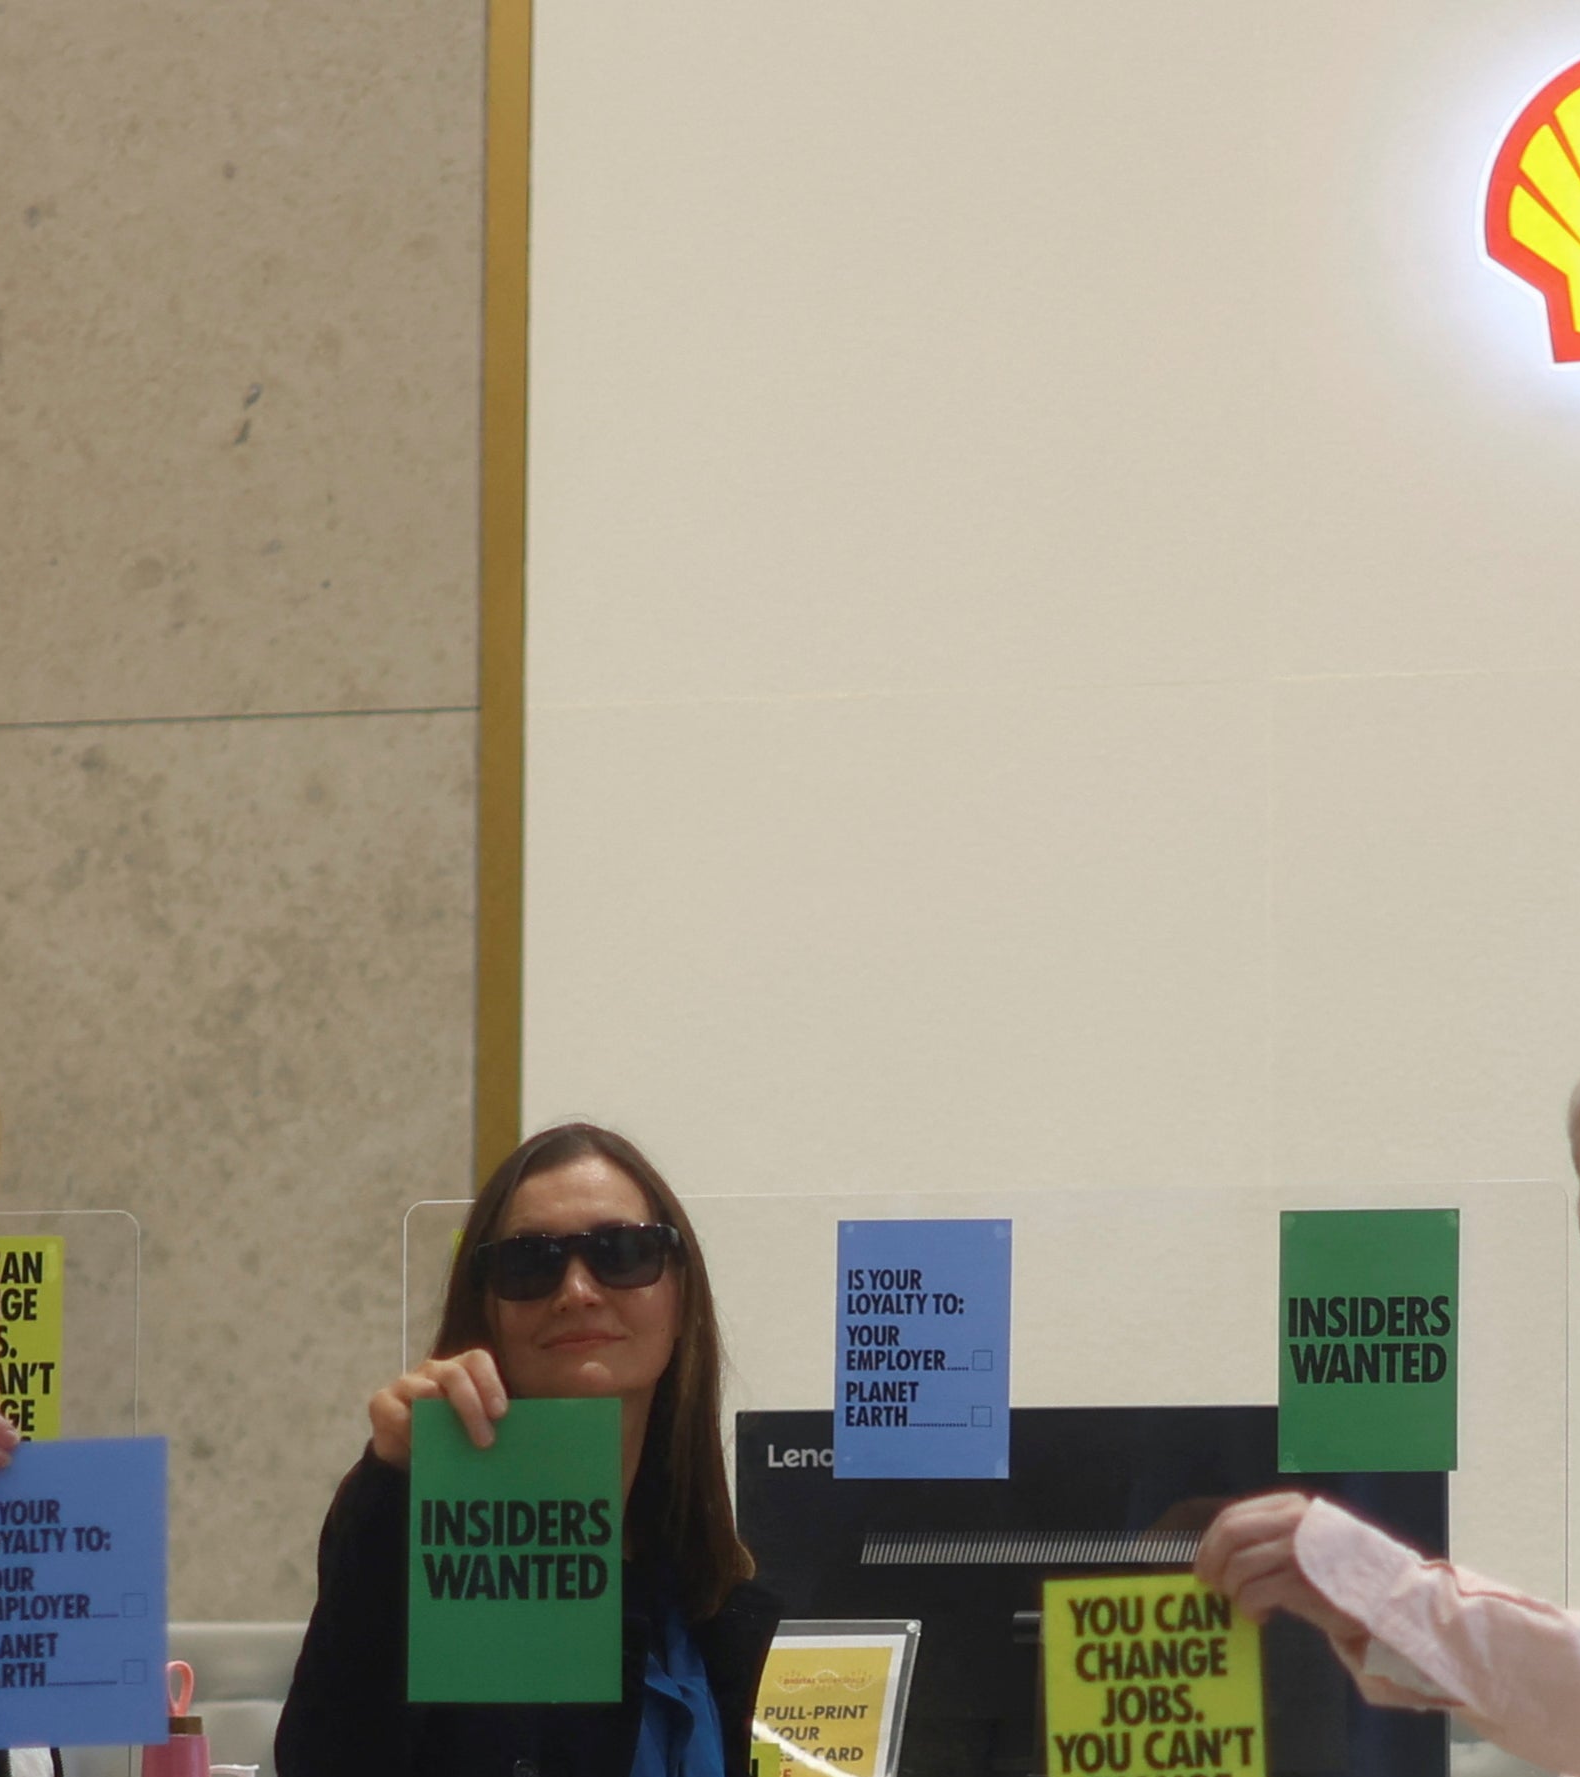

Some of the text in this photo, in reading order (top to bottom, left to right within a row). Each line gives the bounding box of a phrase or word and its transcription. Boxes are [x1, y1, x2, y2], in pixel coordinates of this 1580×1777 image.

[848, 1269, 921, 1290] IS YOUR
[847, 1293, 964, 1315] LOYALTY TO:
[1288, 1295, 1451, 1337] INSIDERS
[846, 1325, 900, 1346] YOUR
[1290, 1343, 1447, 1384] WANTED
[846, 1381, 919, 1403] PLANET
[768, 1444, 834, 1468] Leno
[73, 1526, 111, 1551] TO:
[421, 1499, 613, 1547] INSIDERS
[423, 1554, 608, 1600] WANTED
[1068, 1592, 1231, 1637] YOU CAN
[1075, 1637, 1228, 1681] CHANGE
[764, 1705, 868, 1719] PULL-PRINT
[1101, 1684, 1204, 1726] JOBS.
[1053, 1726, 1255, 1773] YOU CAN'T
